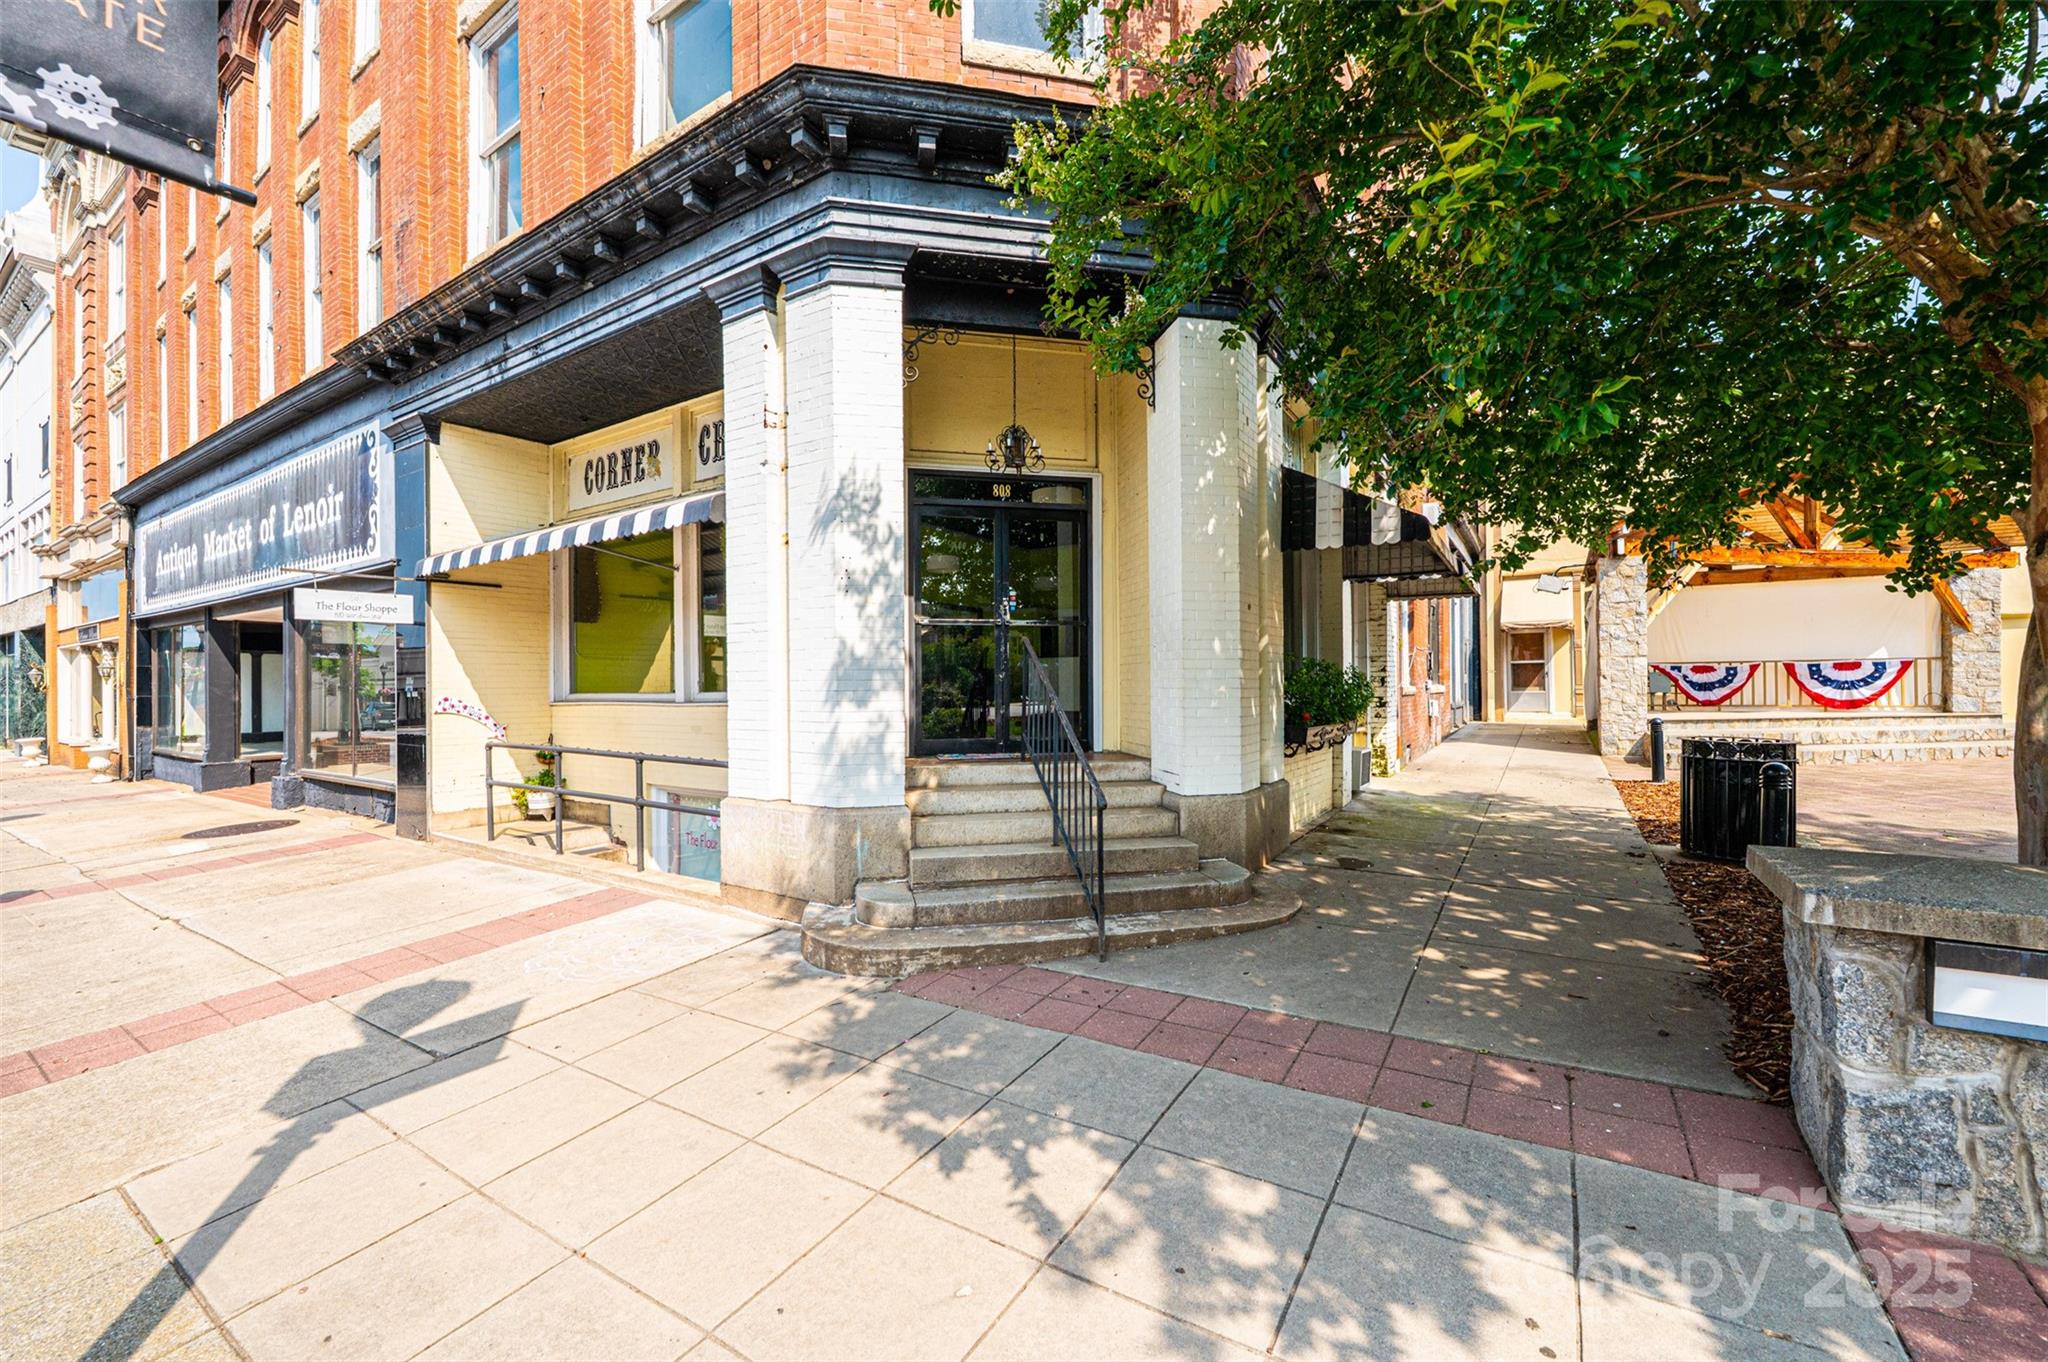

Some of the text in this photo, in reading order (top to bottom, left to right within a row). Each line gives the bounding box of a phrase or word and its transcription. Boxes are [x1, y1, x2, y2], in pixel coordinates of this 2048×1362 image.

[584, 438, 661, 496] CORNER
[992, 483, 1012, 498] 808
[155, 483, 344, 581] Antique Market of Lenoir
[315, 601, 399, 615] The Flour Shoppe
[685, 831, 699, 847] The
